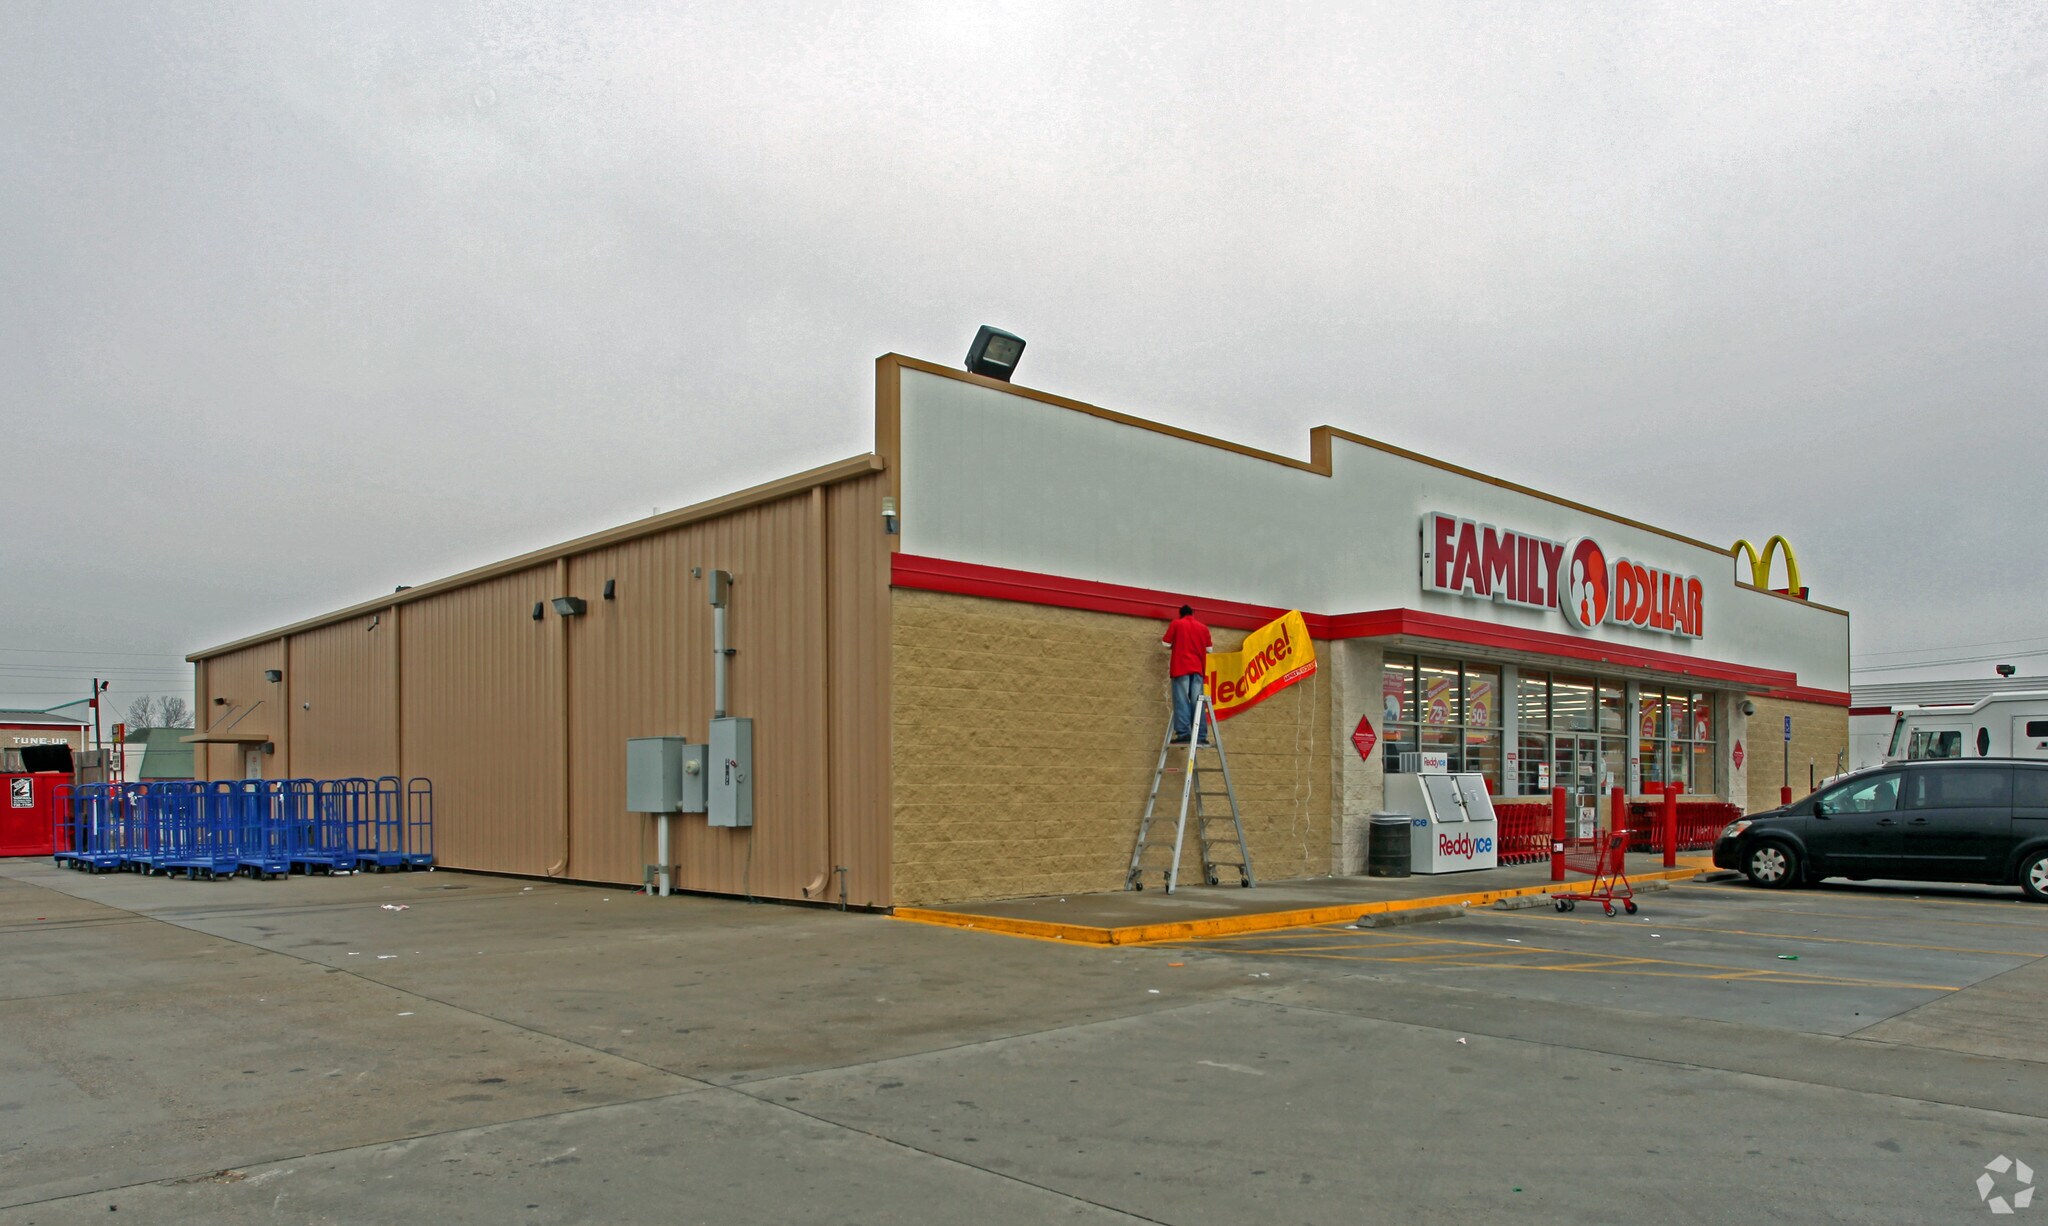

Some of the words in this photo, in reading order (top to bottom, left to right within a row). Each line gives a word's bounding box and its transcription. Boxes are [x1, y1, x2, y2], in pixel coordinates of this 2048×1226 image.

[1436, 516, 1564, 608] FAMILY
[1615, 560, 1702, 636] DOLLAR
[1204, 622, 1292, 706] learance!
[12, 737, 68, 745] TUNE-UP
